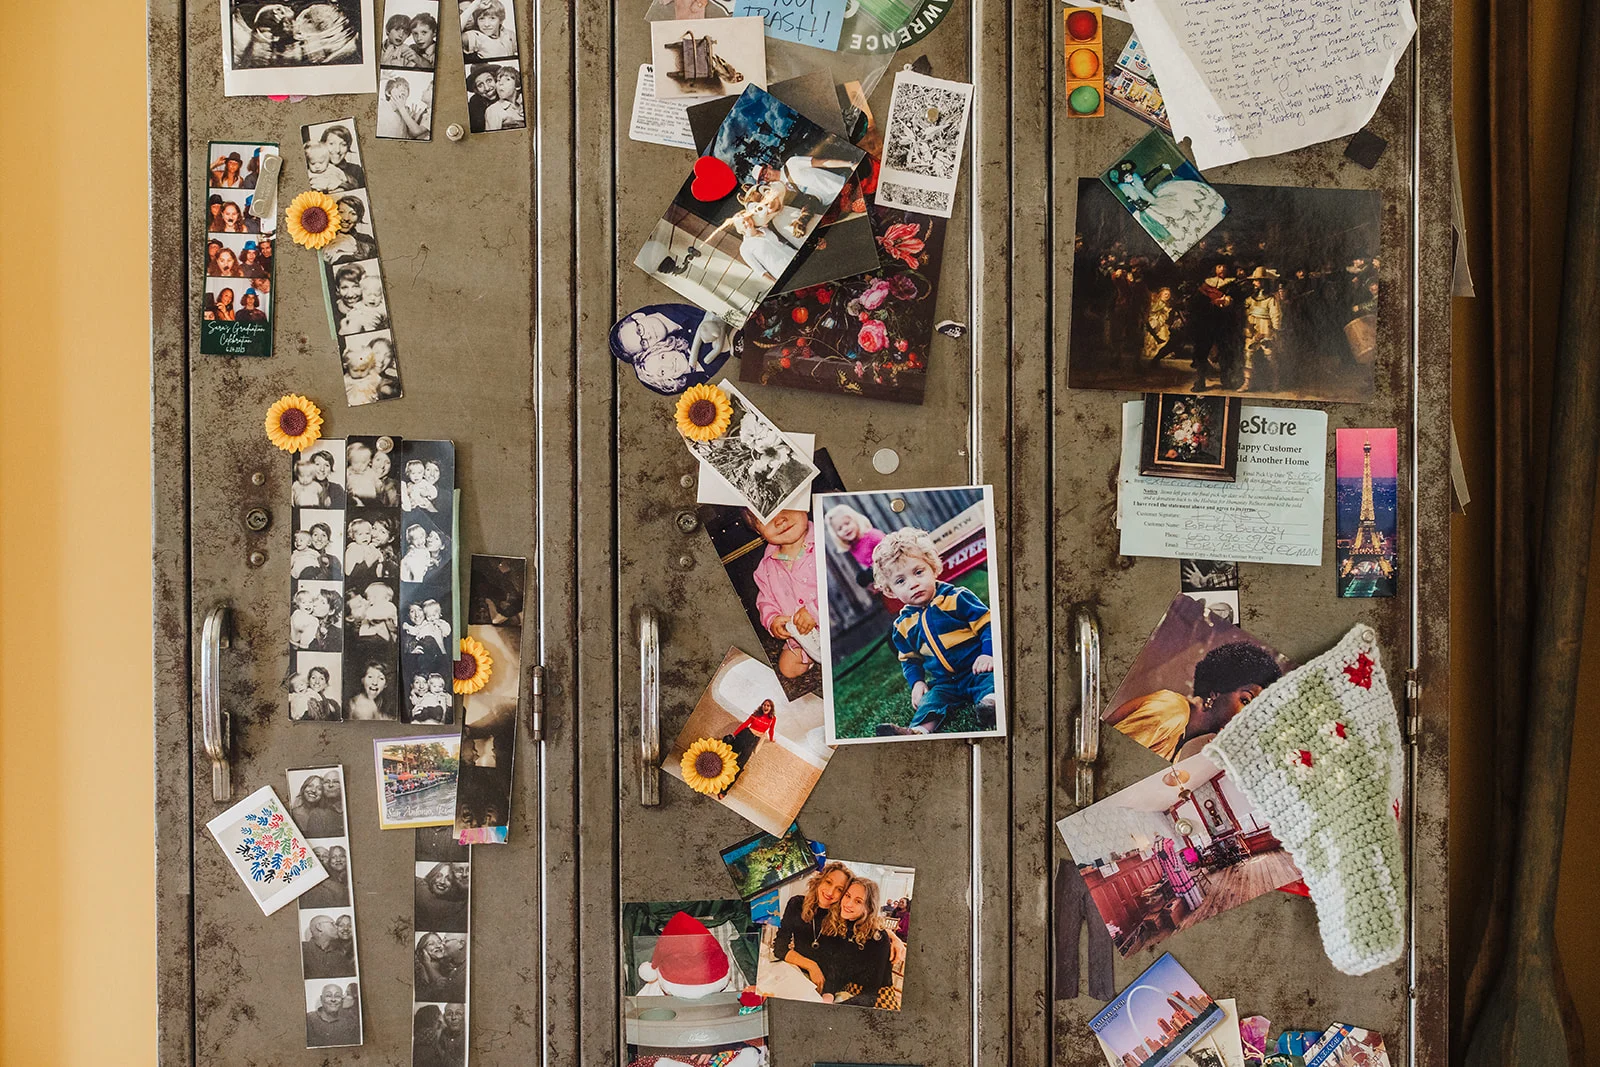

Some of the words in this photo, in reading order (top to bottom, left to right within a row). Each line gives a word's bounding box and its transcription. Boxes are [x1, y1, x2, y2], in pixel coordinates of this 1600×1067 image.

[849, 0, 948, 51] WRENCE
[1240, 415, 1297, 436] eStore
[1263, 443, 1302, 454] Customer
[1237, 454, 1248, 463] ild
[1250, 455, 1283, 465] Another
[1285, 457, 1310, 466] Home
[943, 538, 987, 570] FLYER
